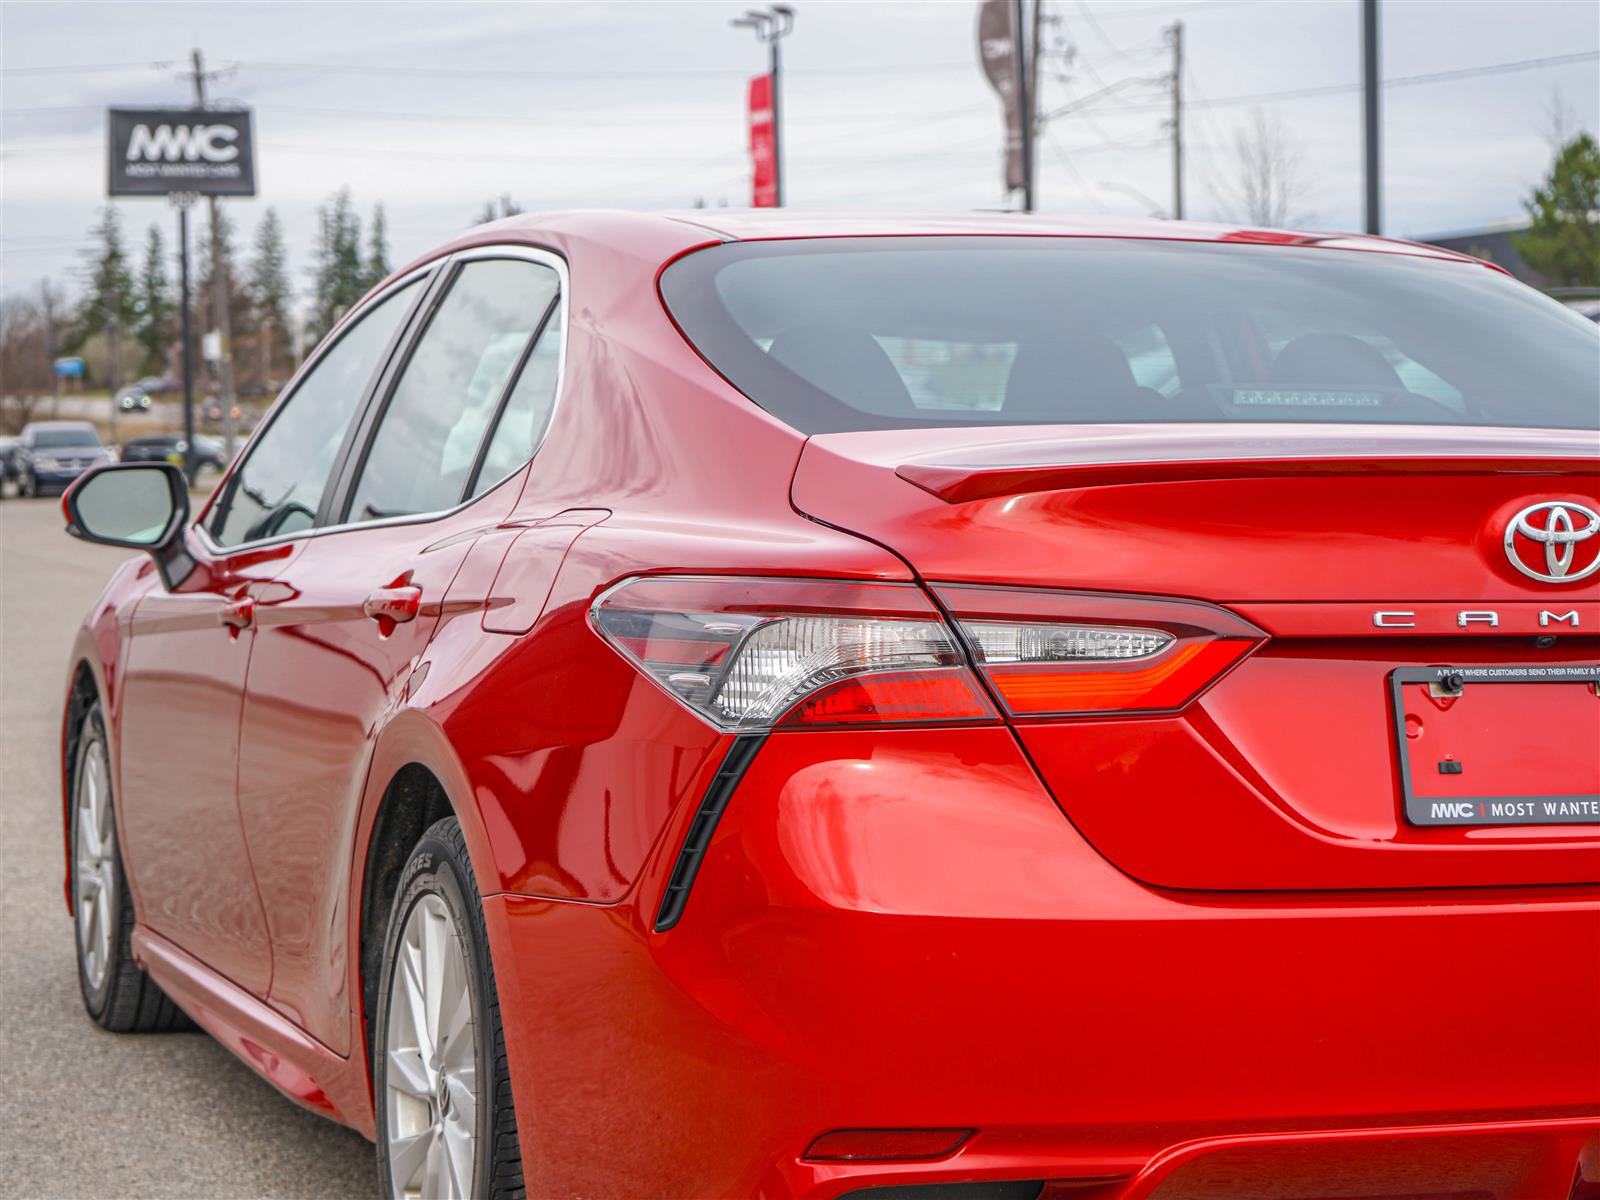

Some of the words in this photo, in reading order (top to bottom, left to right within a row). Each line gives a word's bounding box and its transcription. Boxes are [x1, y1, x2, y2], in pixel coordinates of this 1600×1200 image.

[1373, 610, 1579, 627] CAM
[1488, 668, 1527, 676] CUSTOMERS
[1566, 667, 1589, 675] FAMILY
[1590, 667, 1595, 675] &
[1491, 802, 1535, 817] MOST
[1543, 801, 1599, 815] WANTE
